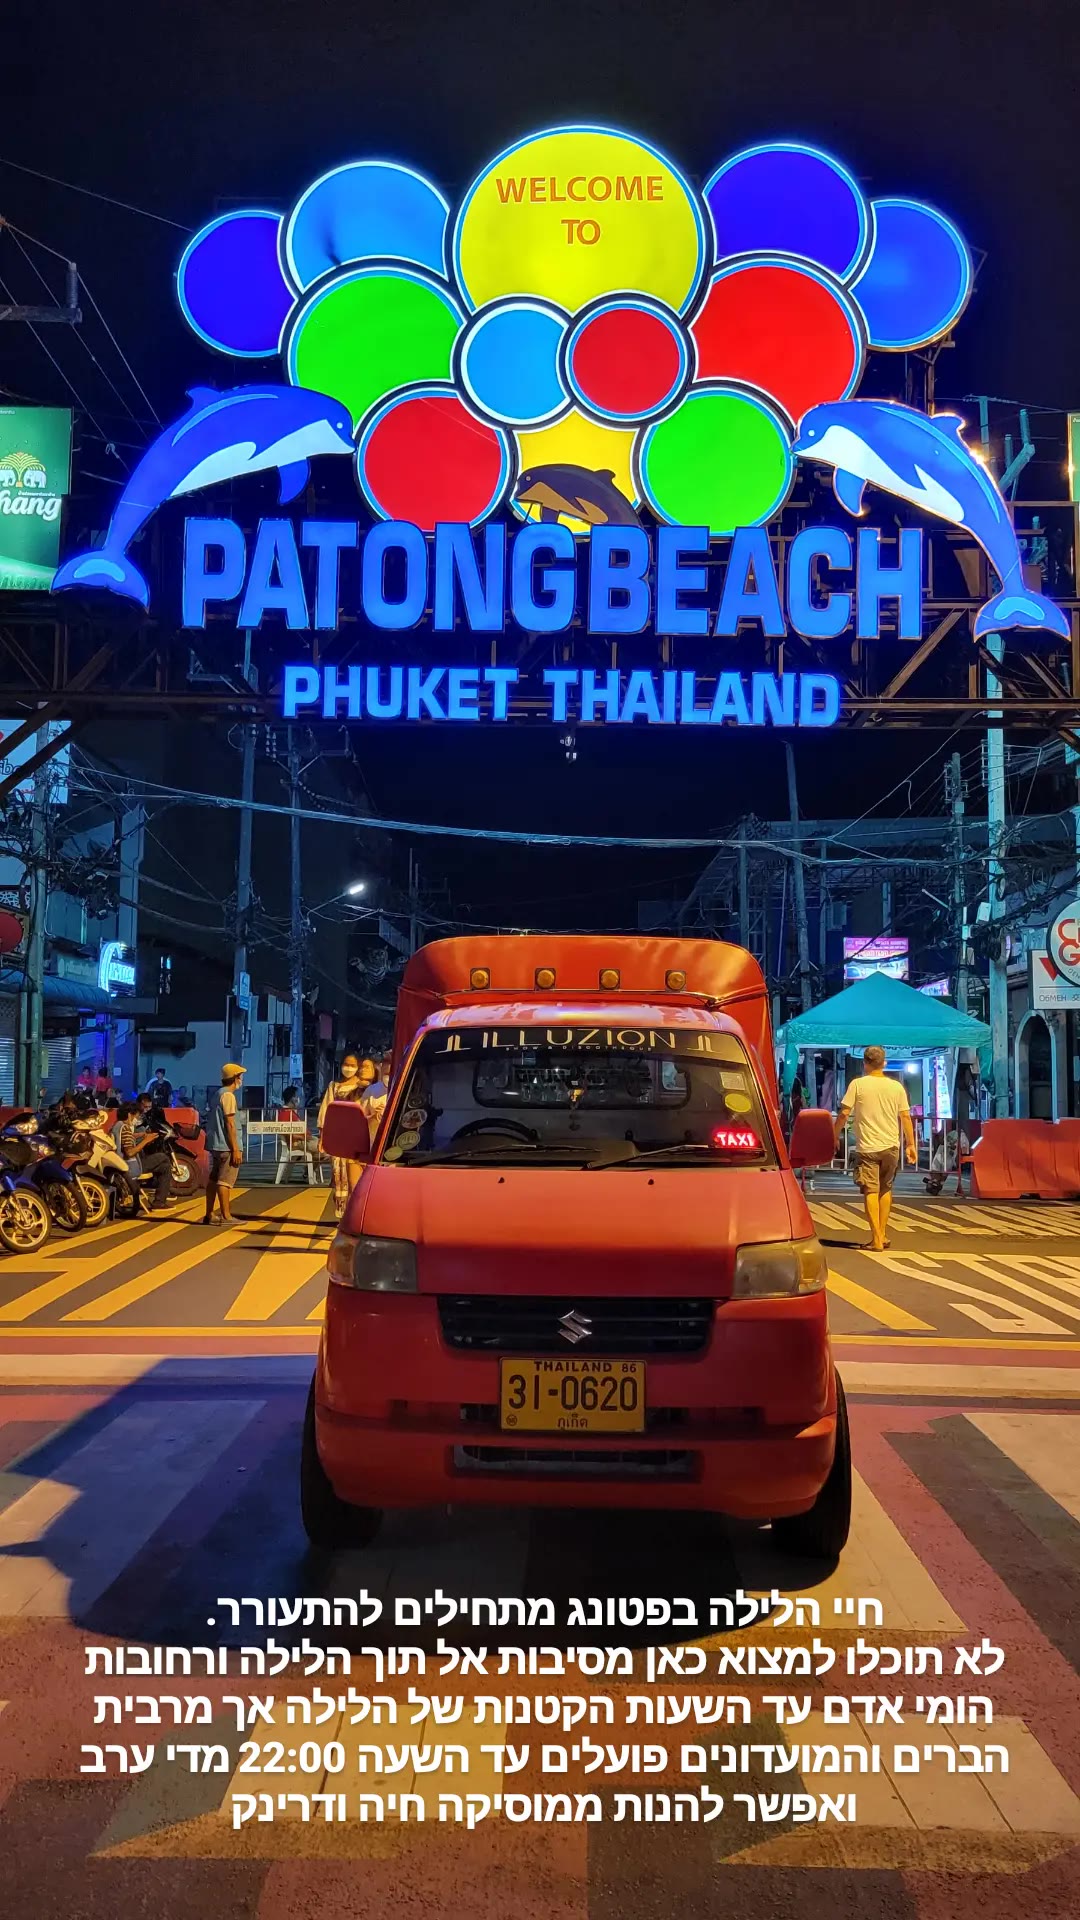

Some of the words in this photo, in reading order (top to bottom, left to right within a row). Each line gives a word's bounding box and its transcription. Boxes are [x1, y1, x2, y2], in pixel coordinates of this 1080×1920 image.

[496, 176, 664, 203] WELCOME
[561, 219, 601, 245] TO
[0, 490, 62, 521] hang
[283, 665, 519, 721] PHUKET
[543, 669, 841, 727] THAILAND
[482, 1028, 676, 1049] ILLUZION
[717, 1132, 756, 1146] TAXI
[534, 1361, 612, 1372] THAILAND
[621, 1363, 637, 1373] 86
[508, 1374, 638, 1411] 31-0620
